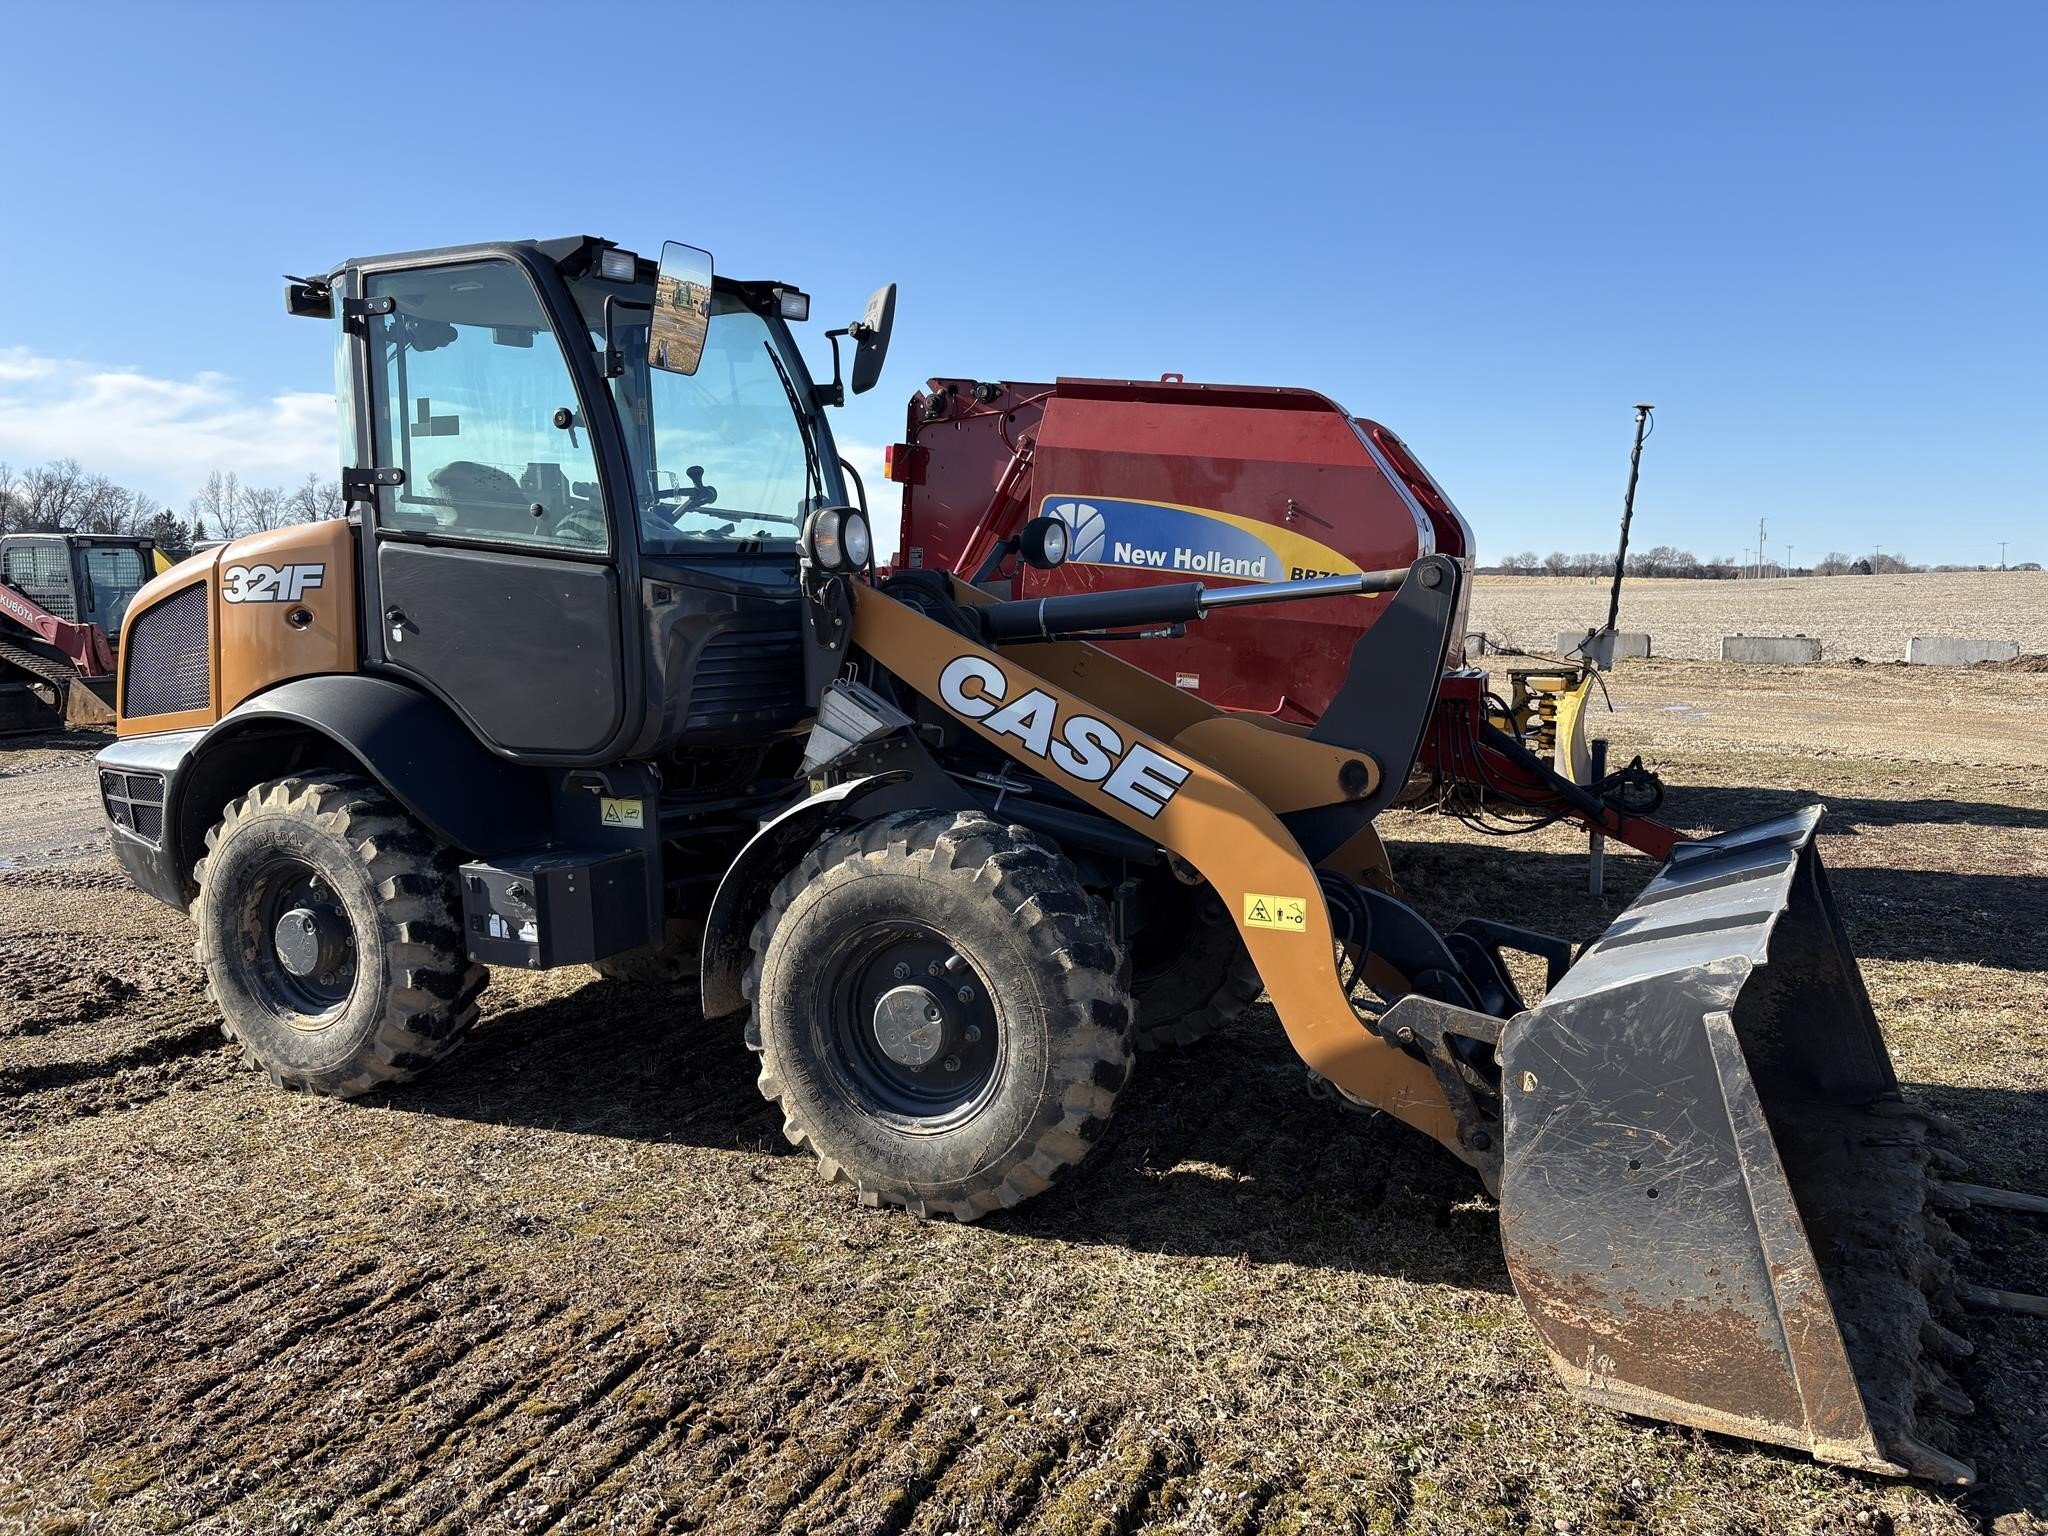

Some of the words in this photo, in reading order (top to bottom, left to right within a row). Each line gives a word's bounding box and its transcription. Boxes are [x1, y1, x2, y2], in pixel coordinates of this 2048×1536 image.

[1113, 542, 1167, 567] New
[1173, 547, 1267, 578] Holland
[222, 563, 326, 604] 321F
[0, 594, 33, 623] KUBOTA
[938, 655, 1193, 820] CASE
